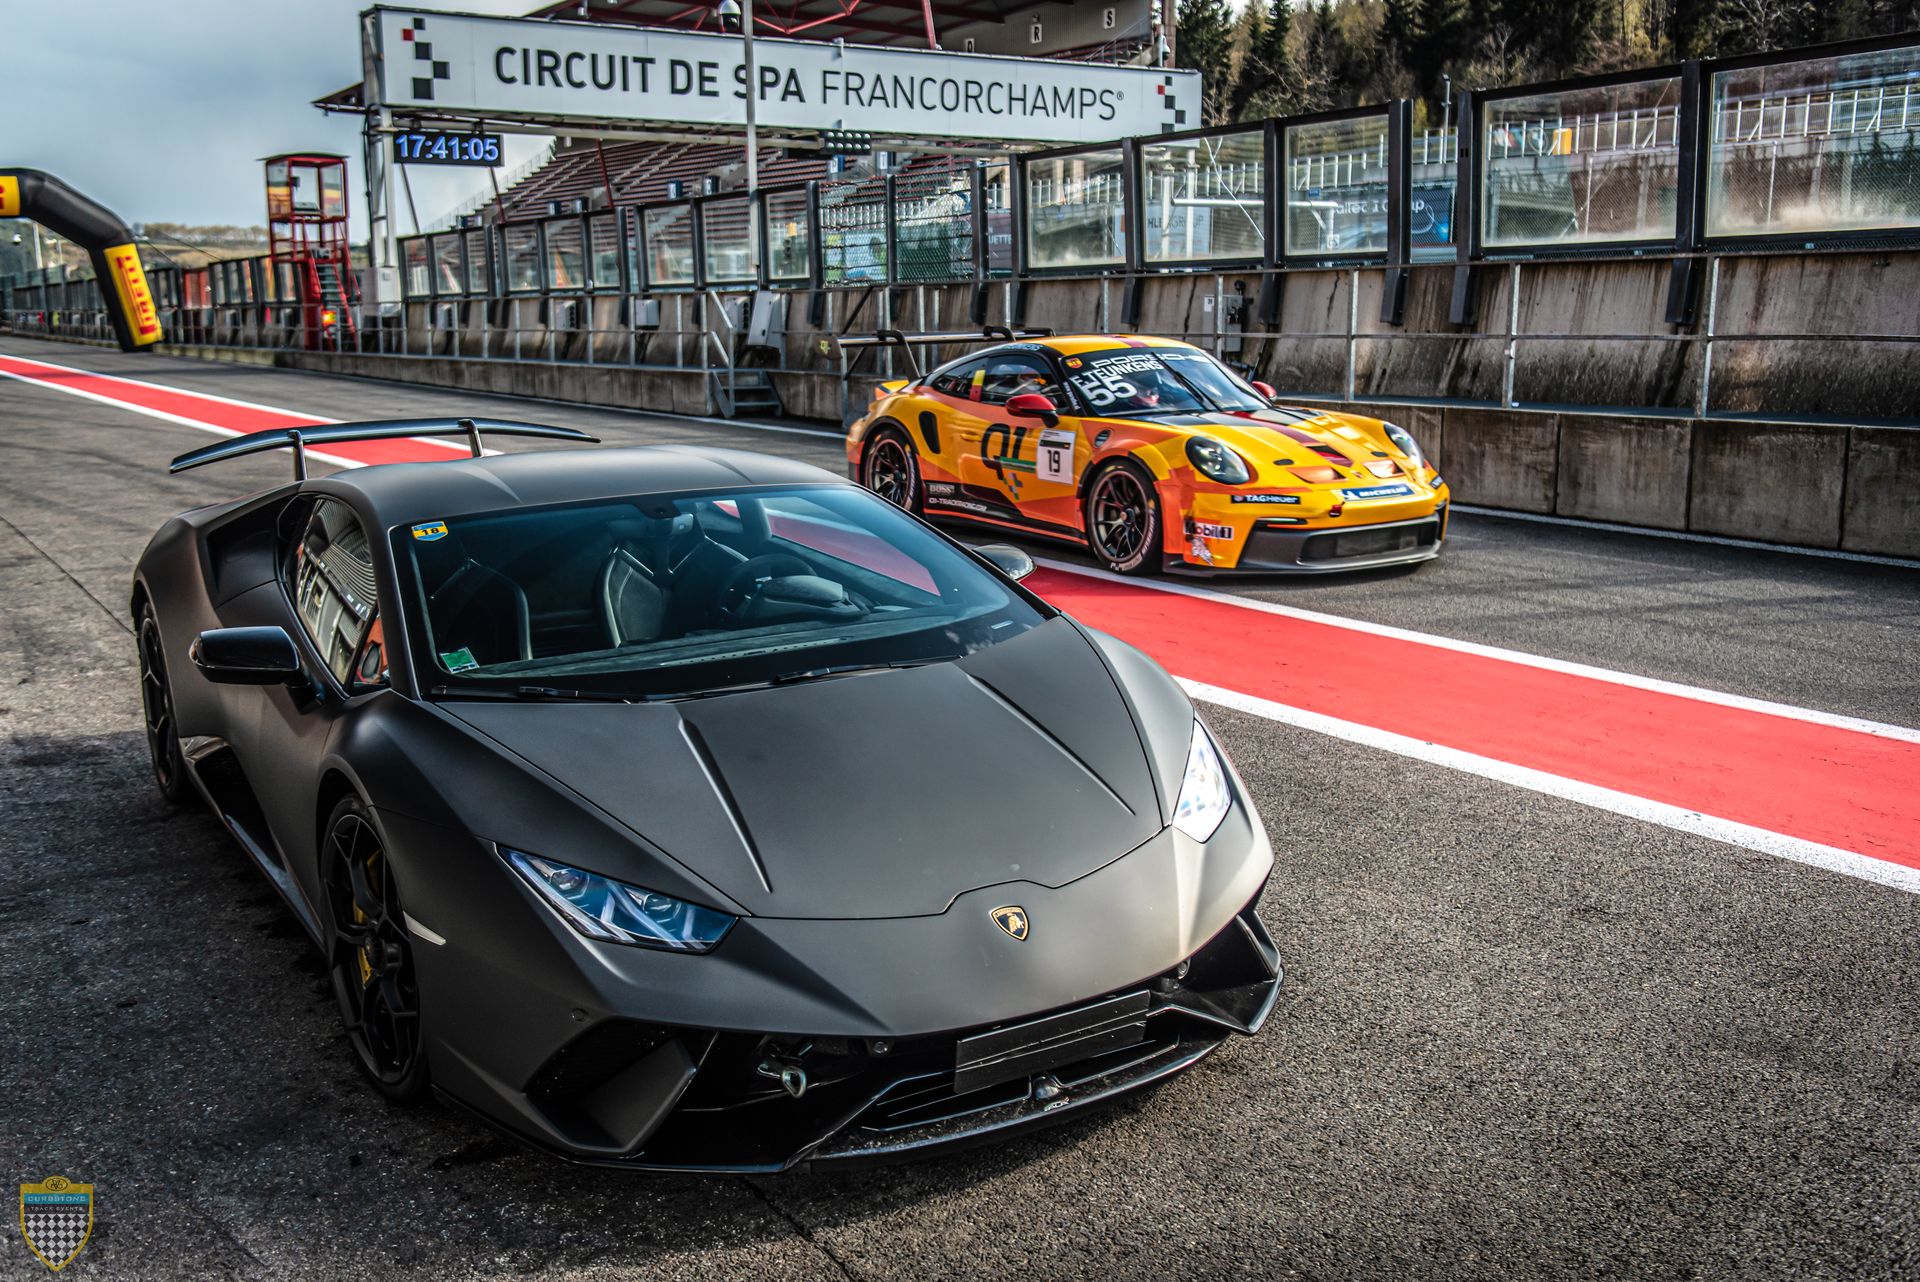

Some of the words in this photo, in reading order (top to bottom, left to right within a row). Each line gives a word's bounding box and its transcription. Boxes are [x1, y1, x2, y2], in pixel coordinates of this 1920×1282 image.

[1033, 26, 1040, 41] R
[495, 46, 656, 93] CIRCUIT
[670, 59, 720, 97] DE
[733, 64, 806, 103] SPA
[396, 134, 499, 161] 17:41:05
[115, 255, 157, 336] PIRELLI
[1081, 375, 1138, 406] 55
[1047, 449, 1060, 473] 19
[1359, 486, 1407, 497] MICHELIN
